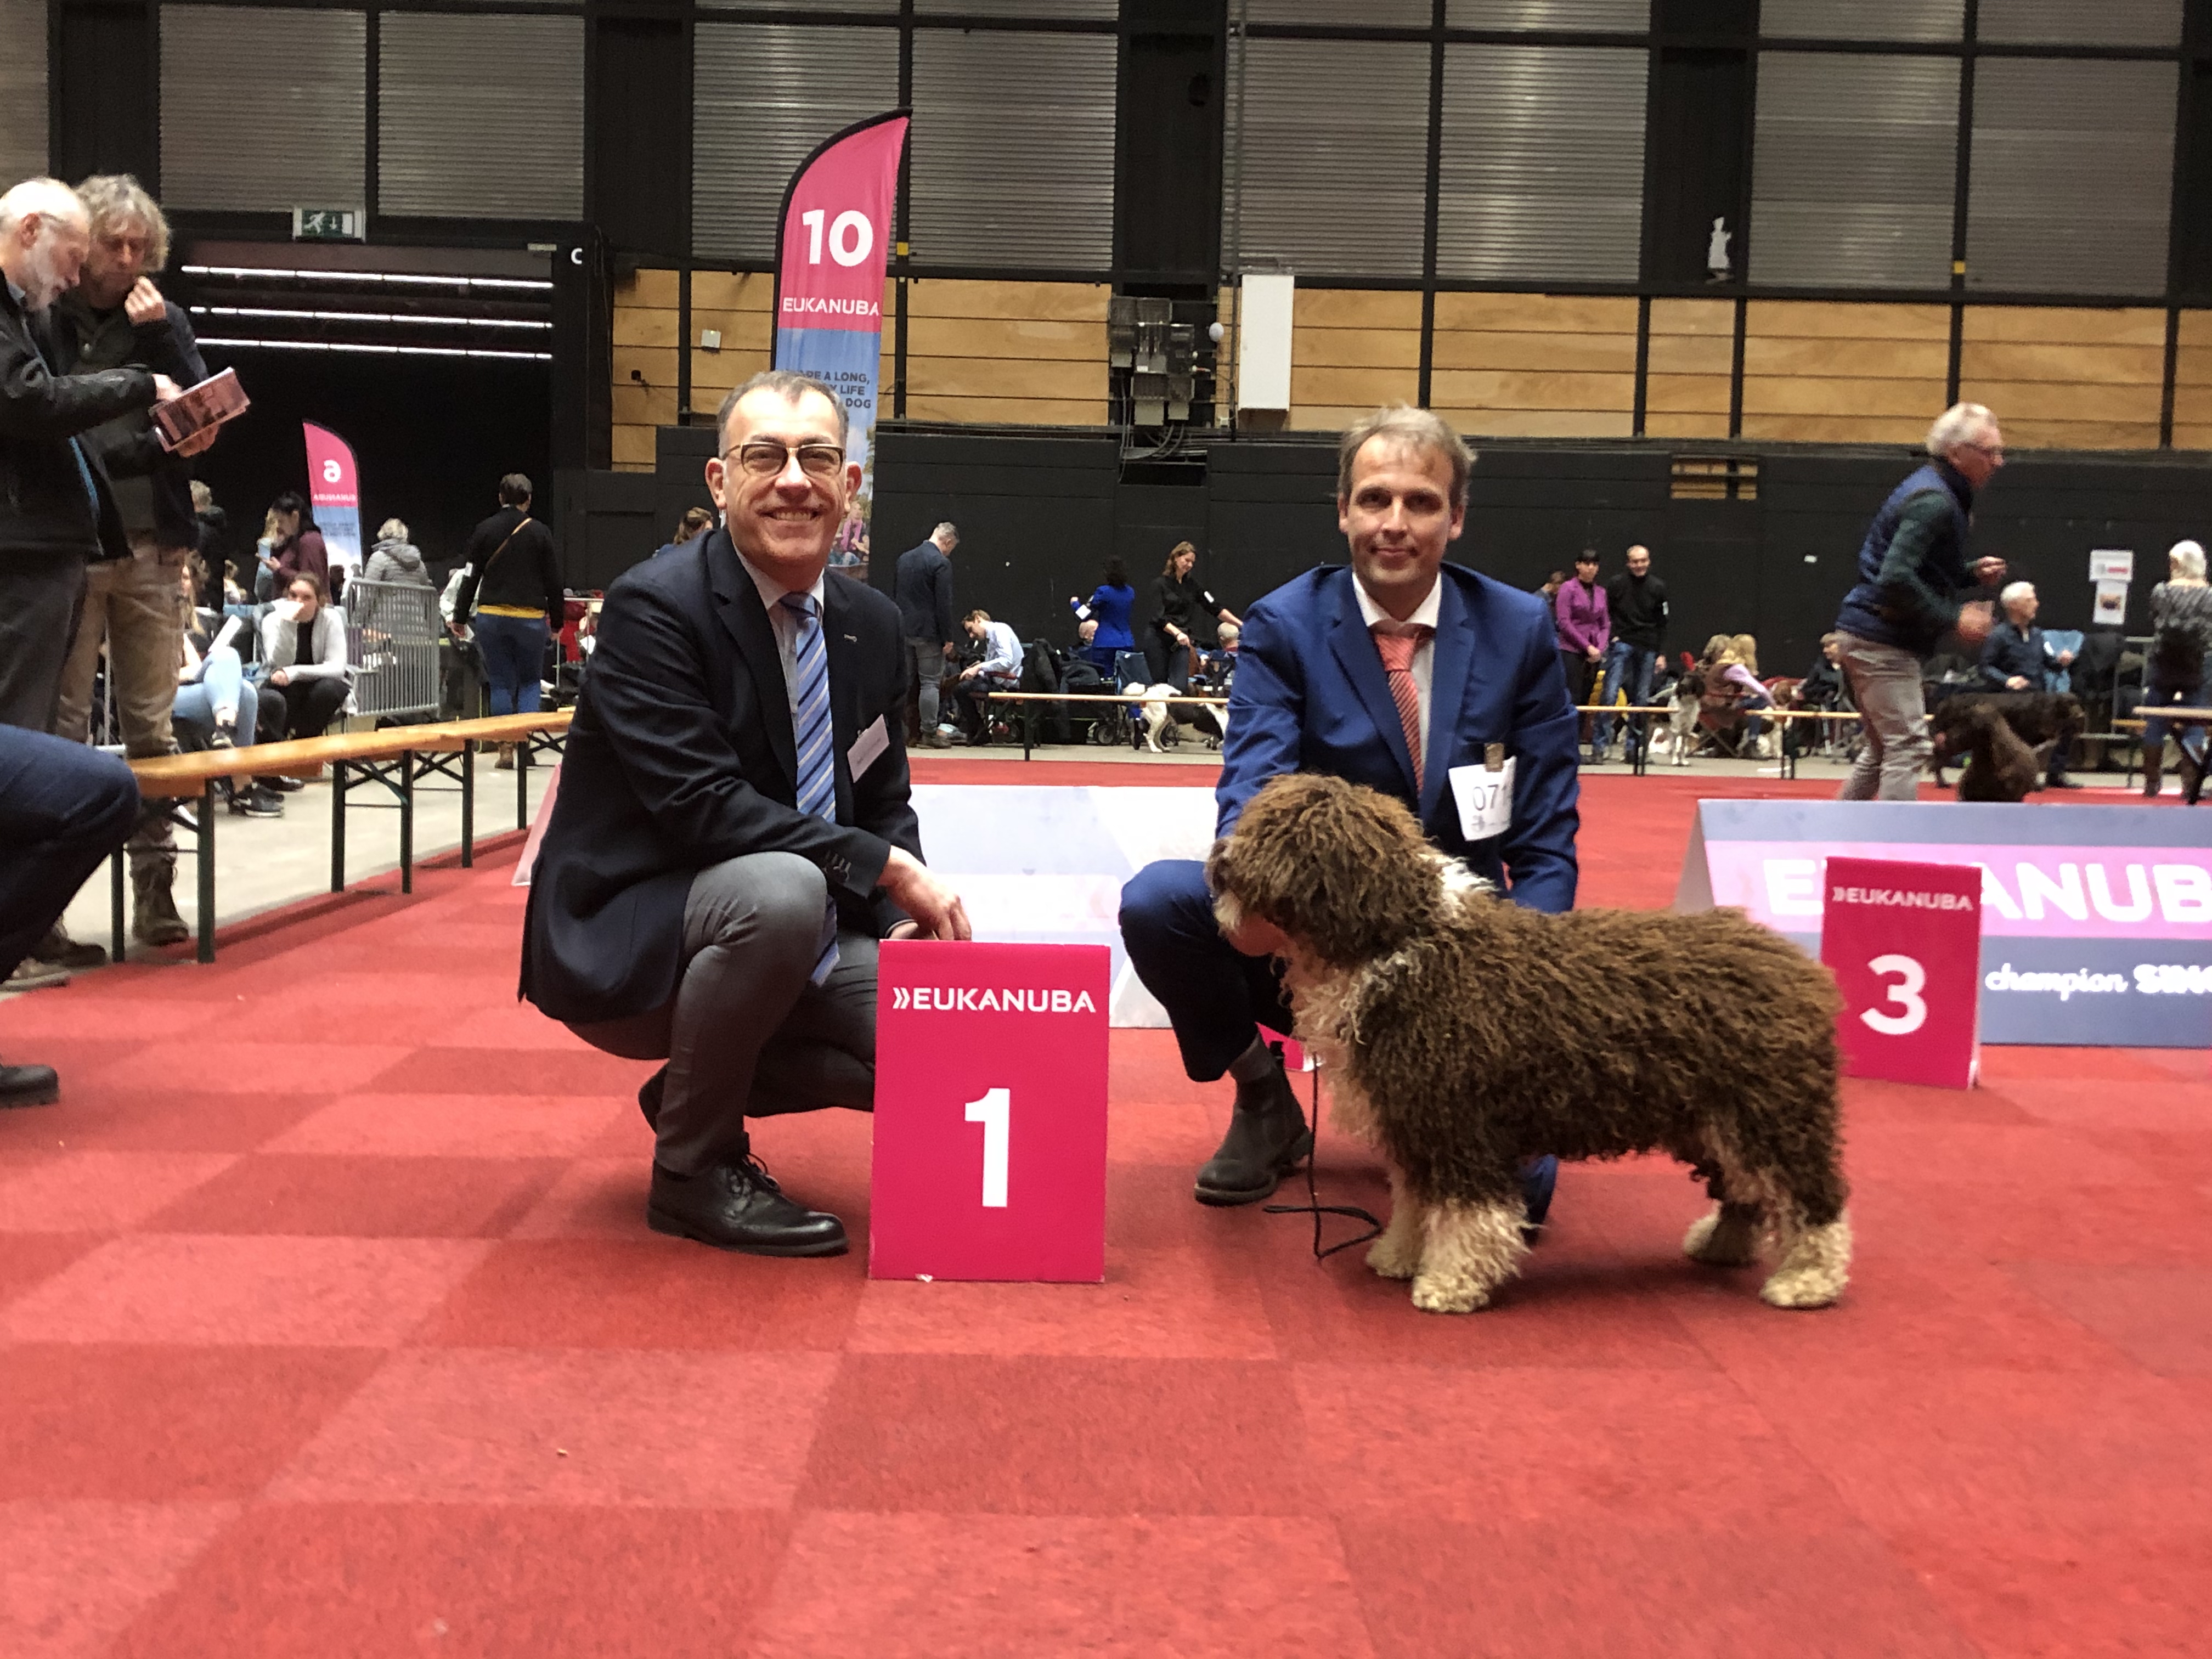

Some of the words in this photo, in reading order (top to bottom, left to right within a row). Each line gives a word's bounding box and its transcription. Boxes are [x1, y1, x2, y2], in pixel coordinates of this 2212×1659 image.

[802, 210, 873, 267] 10
[782, 297, 879, 315] EUKANUBA
[824, 371, 831, 380] A
[834, 371, 870, 385] LONG,
[840, 384, 865, 395] LIFE
[845, 398, 871, 408] DOG
[1847, 888, 1974, 912] EUKANUBA
[1985, 963, 2128, 1001] champion
[913, 988, 1096, 1013] EUKANUBA
[1859, 954, 1927, 1035] 3
[964, 1088, 1011, 1207] 1
